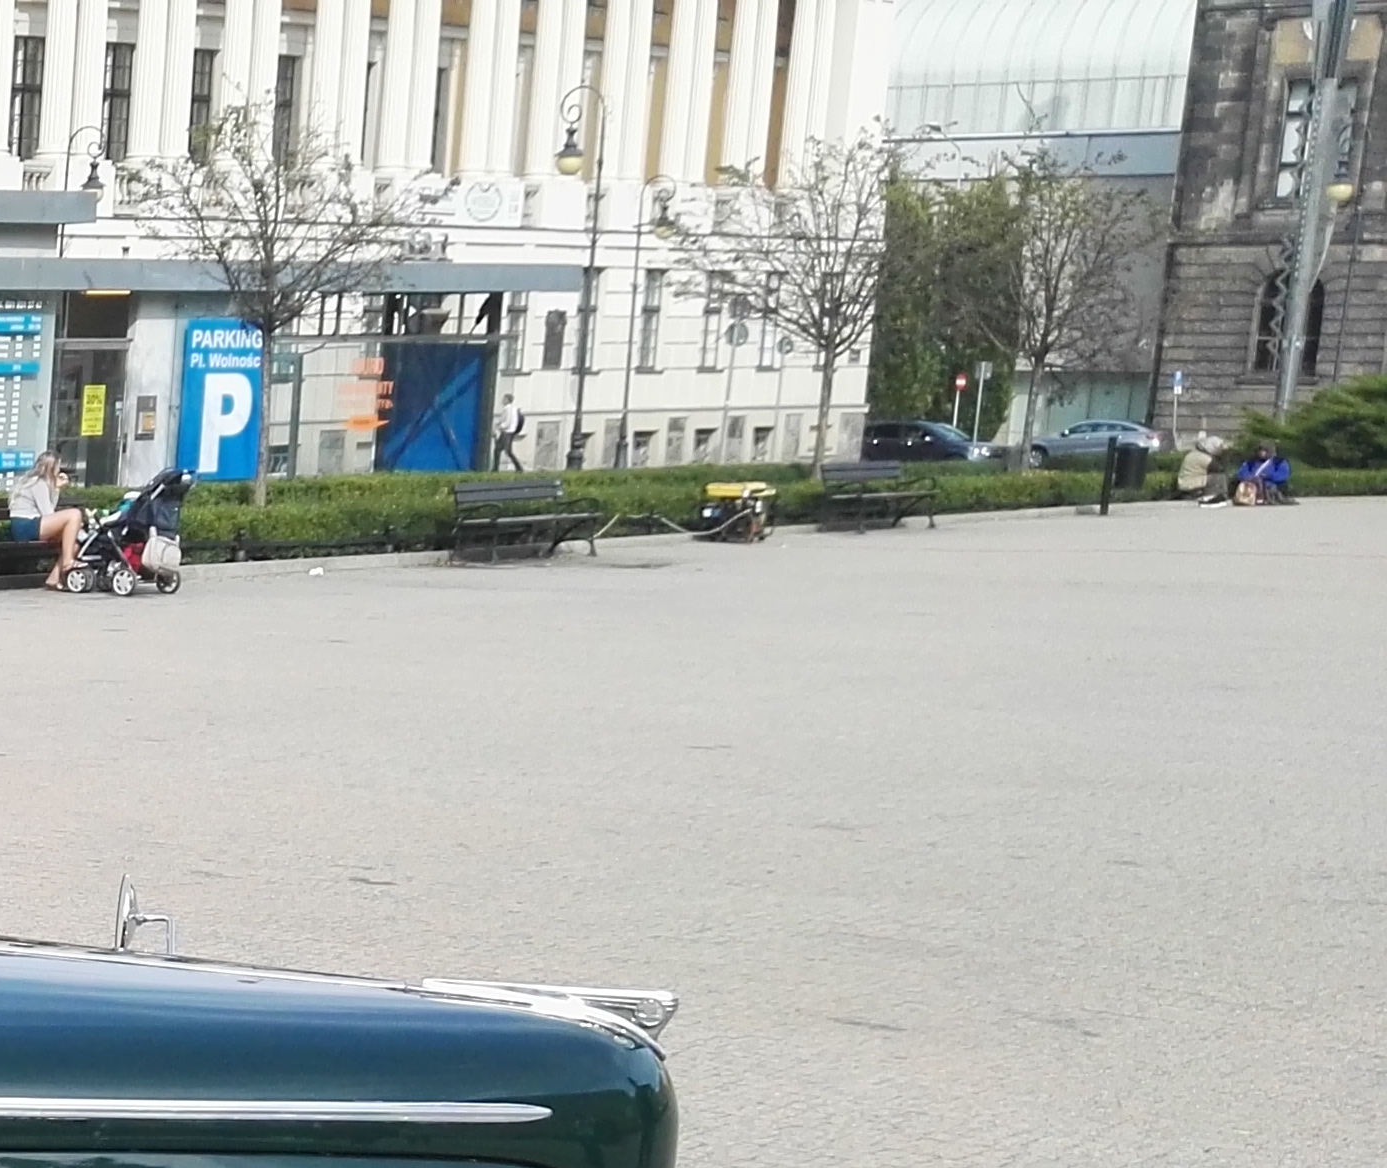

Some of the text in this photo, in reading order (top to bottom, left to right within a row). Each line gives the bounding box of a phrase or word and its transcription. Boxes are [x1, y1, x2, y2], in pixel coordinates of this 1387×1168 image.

[192, 328, 264, 349] PARKING
[190, 352, 261, 369] Pl. Wolnośc
[198, 372, 253, 473] P
